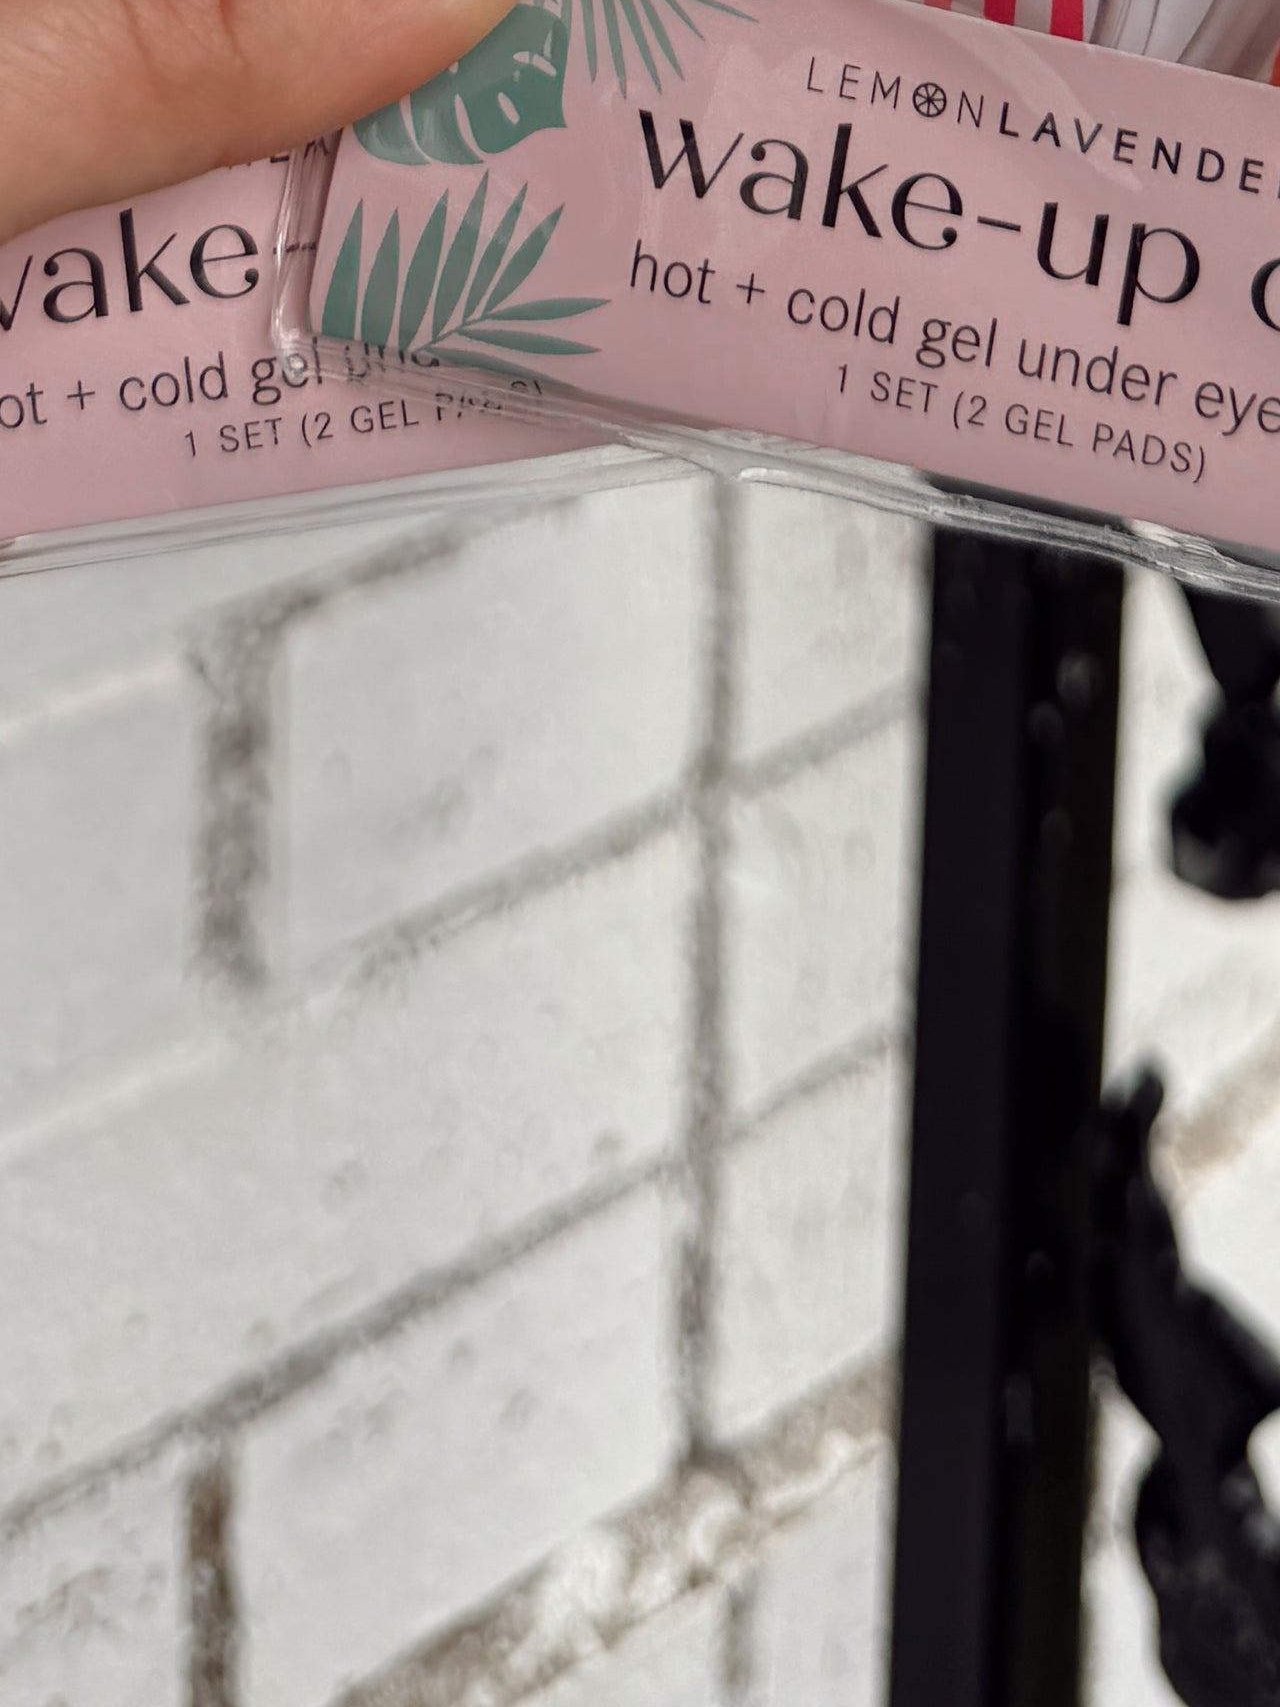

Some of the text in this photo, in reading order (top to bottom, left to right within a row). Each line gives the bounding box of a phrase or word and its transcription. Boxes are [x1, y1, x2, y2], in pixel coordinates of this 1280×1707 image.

[639, 110, 1200, 325] wake-up
[67, 380, 96, 410] +
[119, 352, 228, 412] cold
[252, 336, 322, 405] gel
[630, 239, 715, 304] hot
[737, 273, 765, 304] +
[787, 288, 899, 344] cold
[916, 318, 997, 368] gel
[1018, 338, 1177, 405] under
[184, 431, 197, 457] 1
[220, 418, 282, 453] SET
[300, 412, 333, 448] (2
[350, 399, 419, 433] GEL
[837, 364, 1206, 483] 1 SET (2 GEL PADS)
